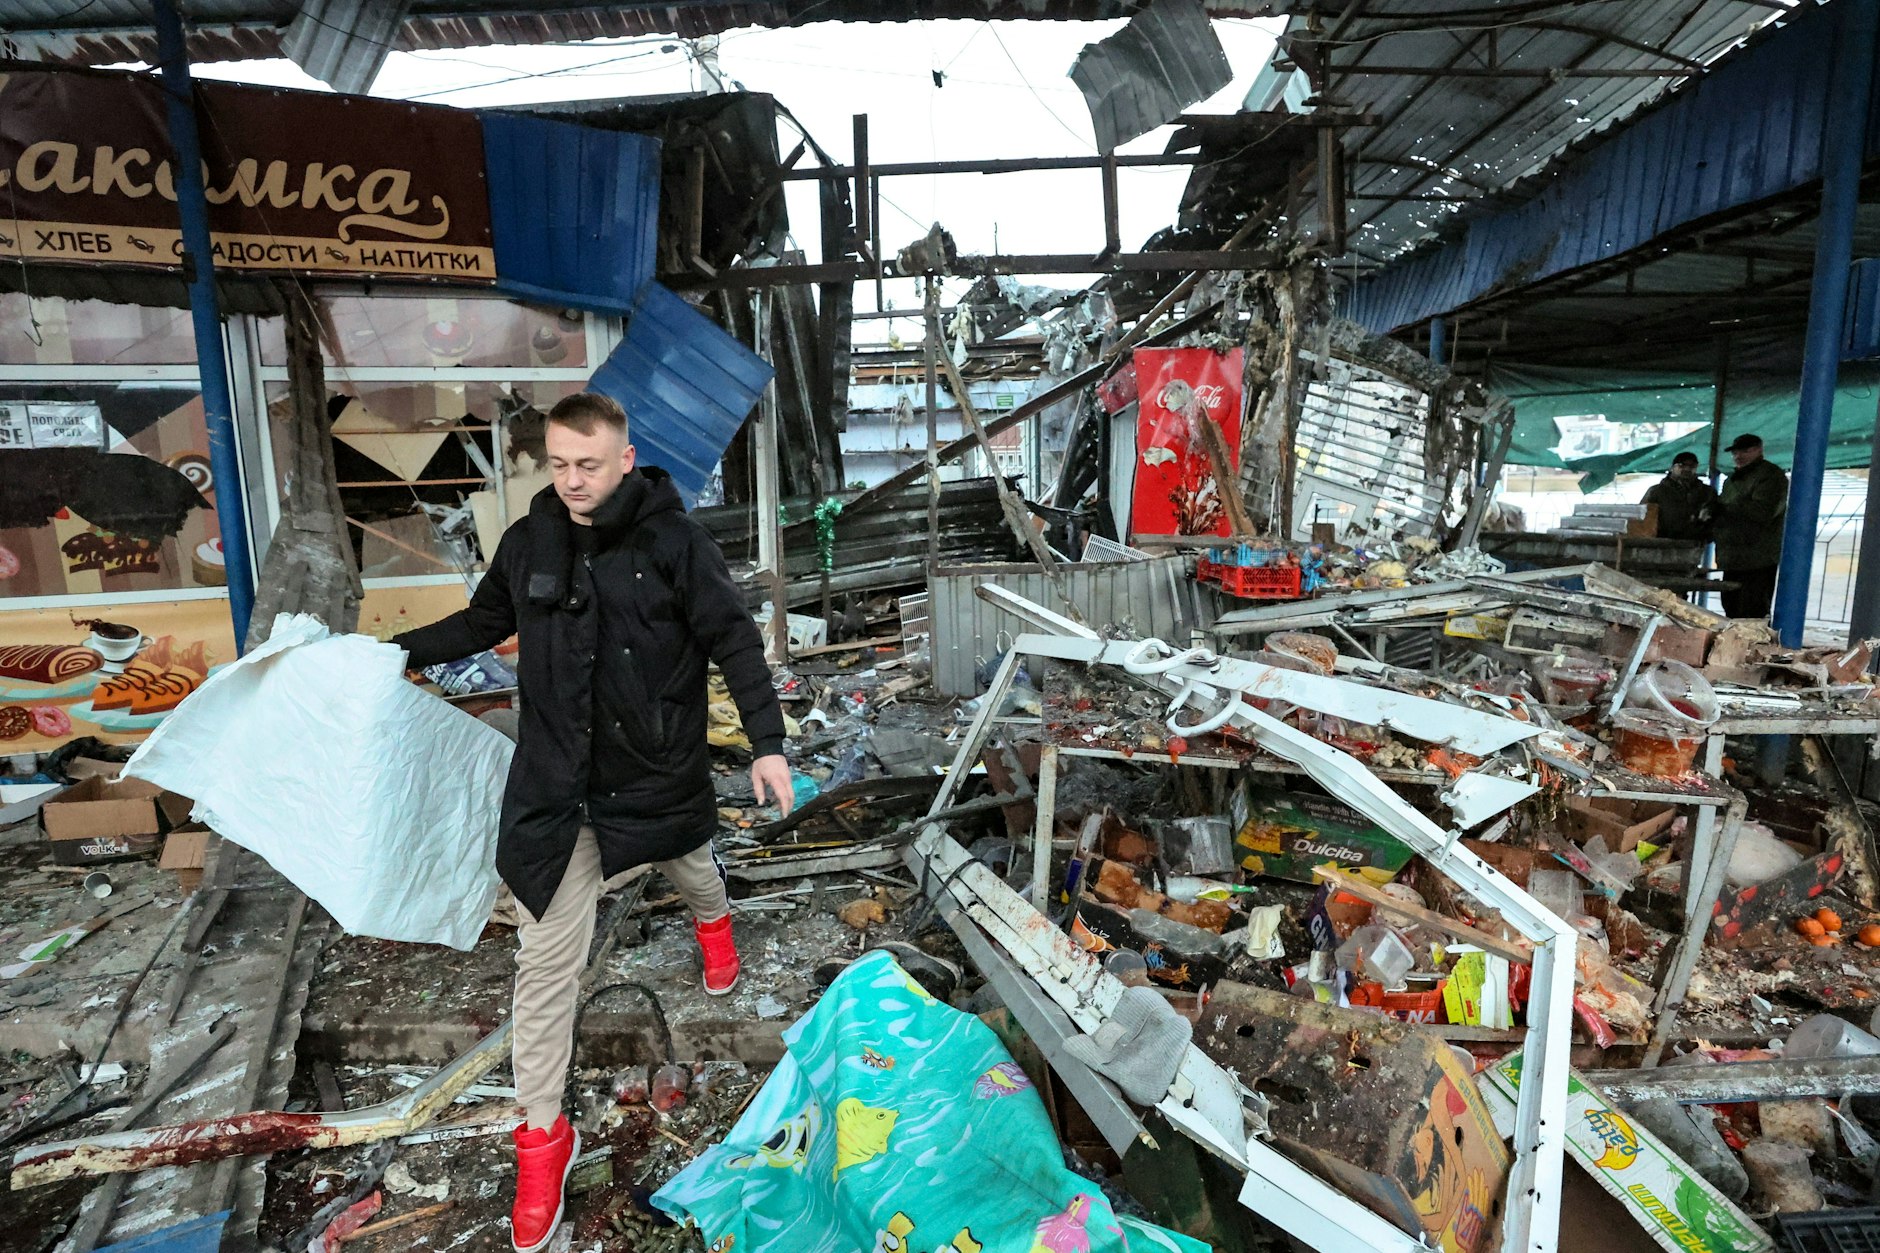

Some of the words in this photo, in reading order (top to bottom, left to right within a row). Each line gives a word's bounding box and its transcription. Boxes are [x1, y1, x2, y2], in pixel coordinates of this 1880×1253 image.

[34, 229, 113, 254] ХЛЕБ
[171, 238, 318, 264] САДОСТИ
[360, 248, 481, 271] НАПИТКИ
[1293, 839, 1364, 862] Dulcita
